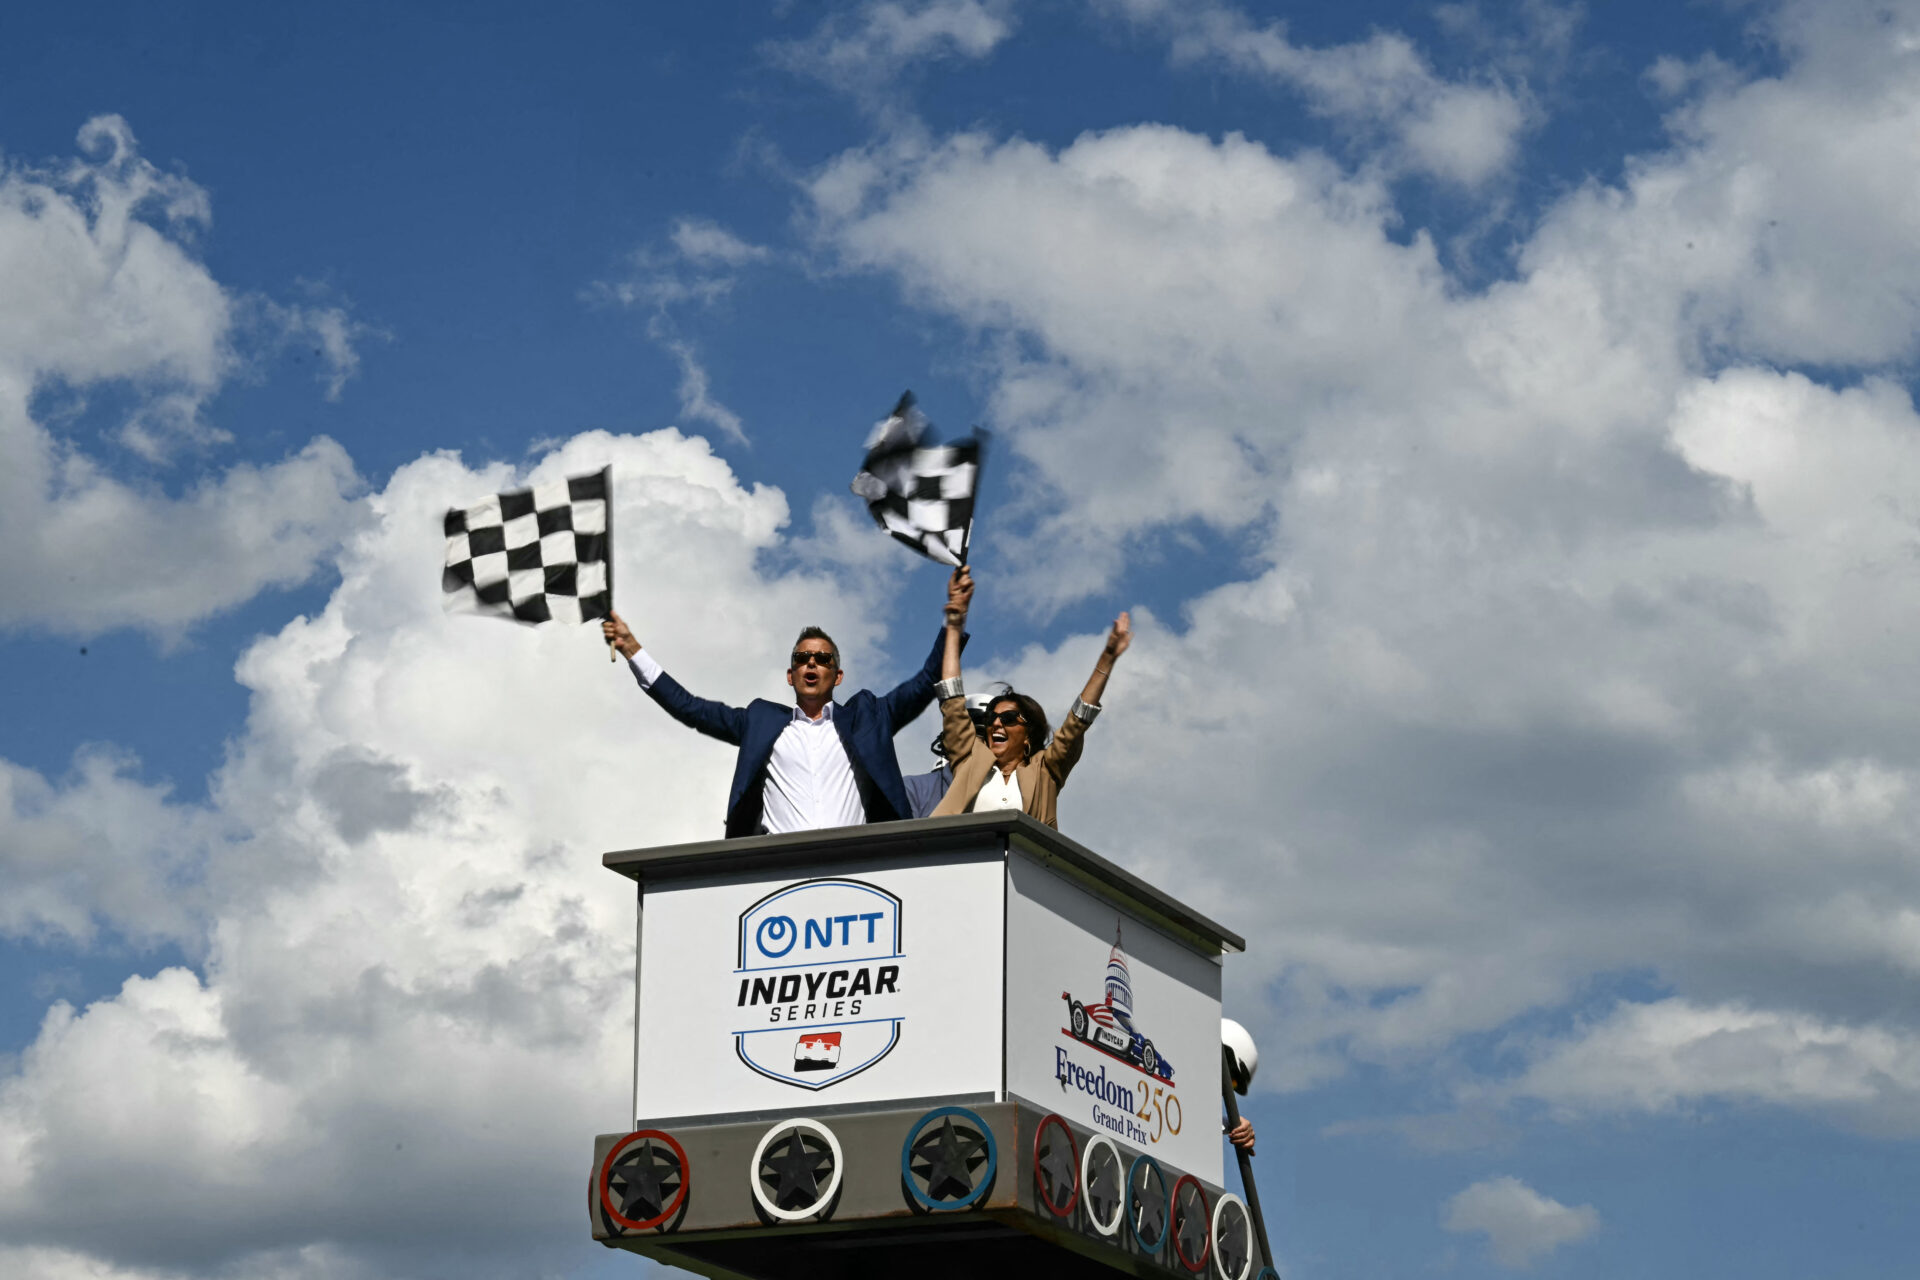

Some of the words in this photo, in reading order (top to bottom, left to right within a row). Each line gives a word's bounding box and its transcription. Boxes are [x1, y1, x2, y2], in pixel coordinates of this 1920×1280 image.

[805, 912, 884, 949] NTT
[738, 965, 900, 1006] INDYCAR
[770, 1000, 862, 1022] SERIES
[1101, 1029, 1124, 1048] INDYCAR
[1055, 1045, 1135, 1114] Freedom
[1136, 1080, 1182, 1143] 250
[1092, 1104, 1124, 1135] Grand
[1126, 1120, 1148, 1145] Prix
